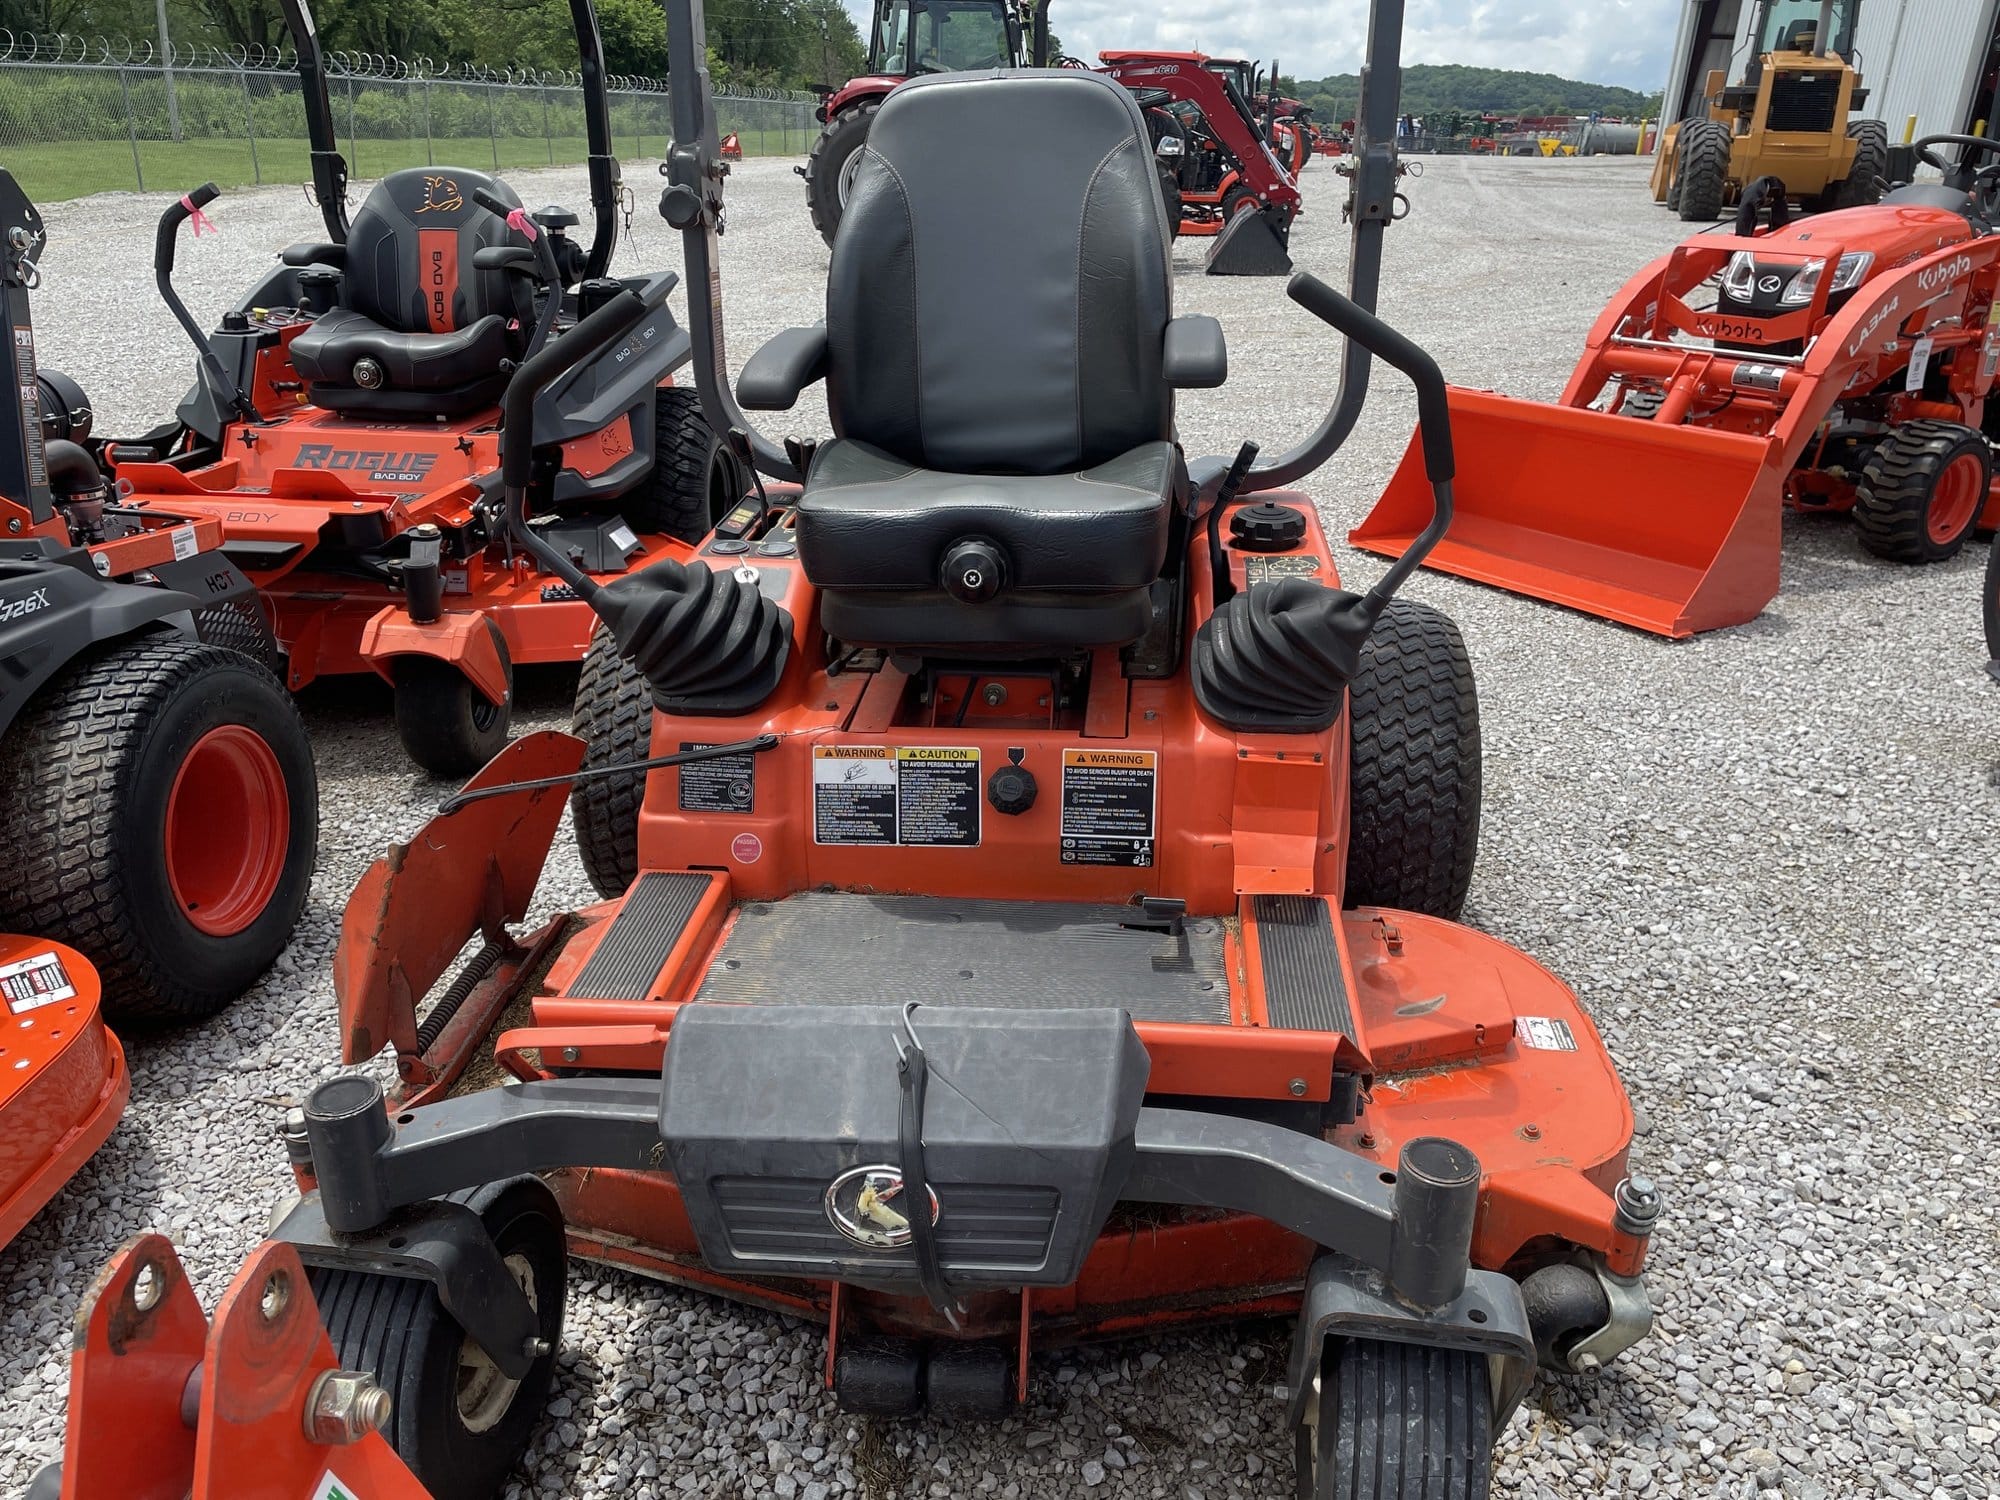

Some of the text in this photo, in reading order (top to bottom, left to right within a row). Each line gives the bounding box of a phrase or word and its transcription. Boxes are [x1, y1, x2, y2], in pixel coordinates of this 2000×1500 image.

[1918, 254, 1971, 290] Kubota
[432, 251, 446, 325] BAD BOY
[1696, 317, 1762, 340] Kubota
[1849, 296, 1899, 358] LA344
[616, 326, 656, 362] BAD BOY
[374, 472, 421, 481] BAD BOY
[226, 511, 280, 523] BOY
[205, 570, 237, 594] HOT
[835, 748, 886, 758] WARNING
[919, 750, 967, 759] CAUTION
[1090, 754, 1144, 764] WARNING
